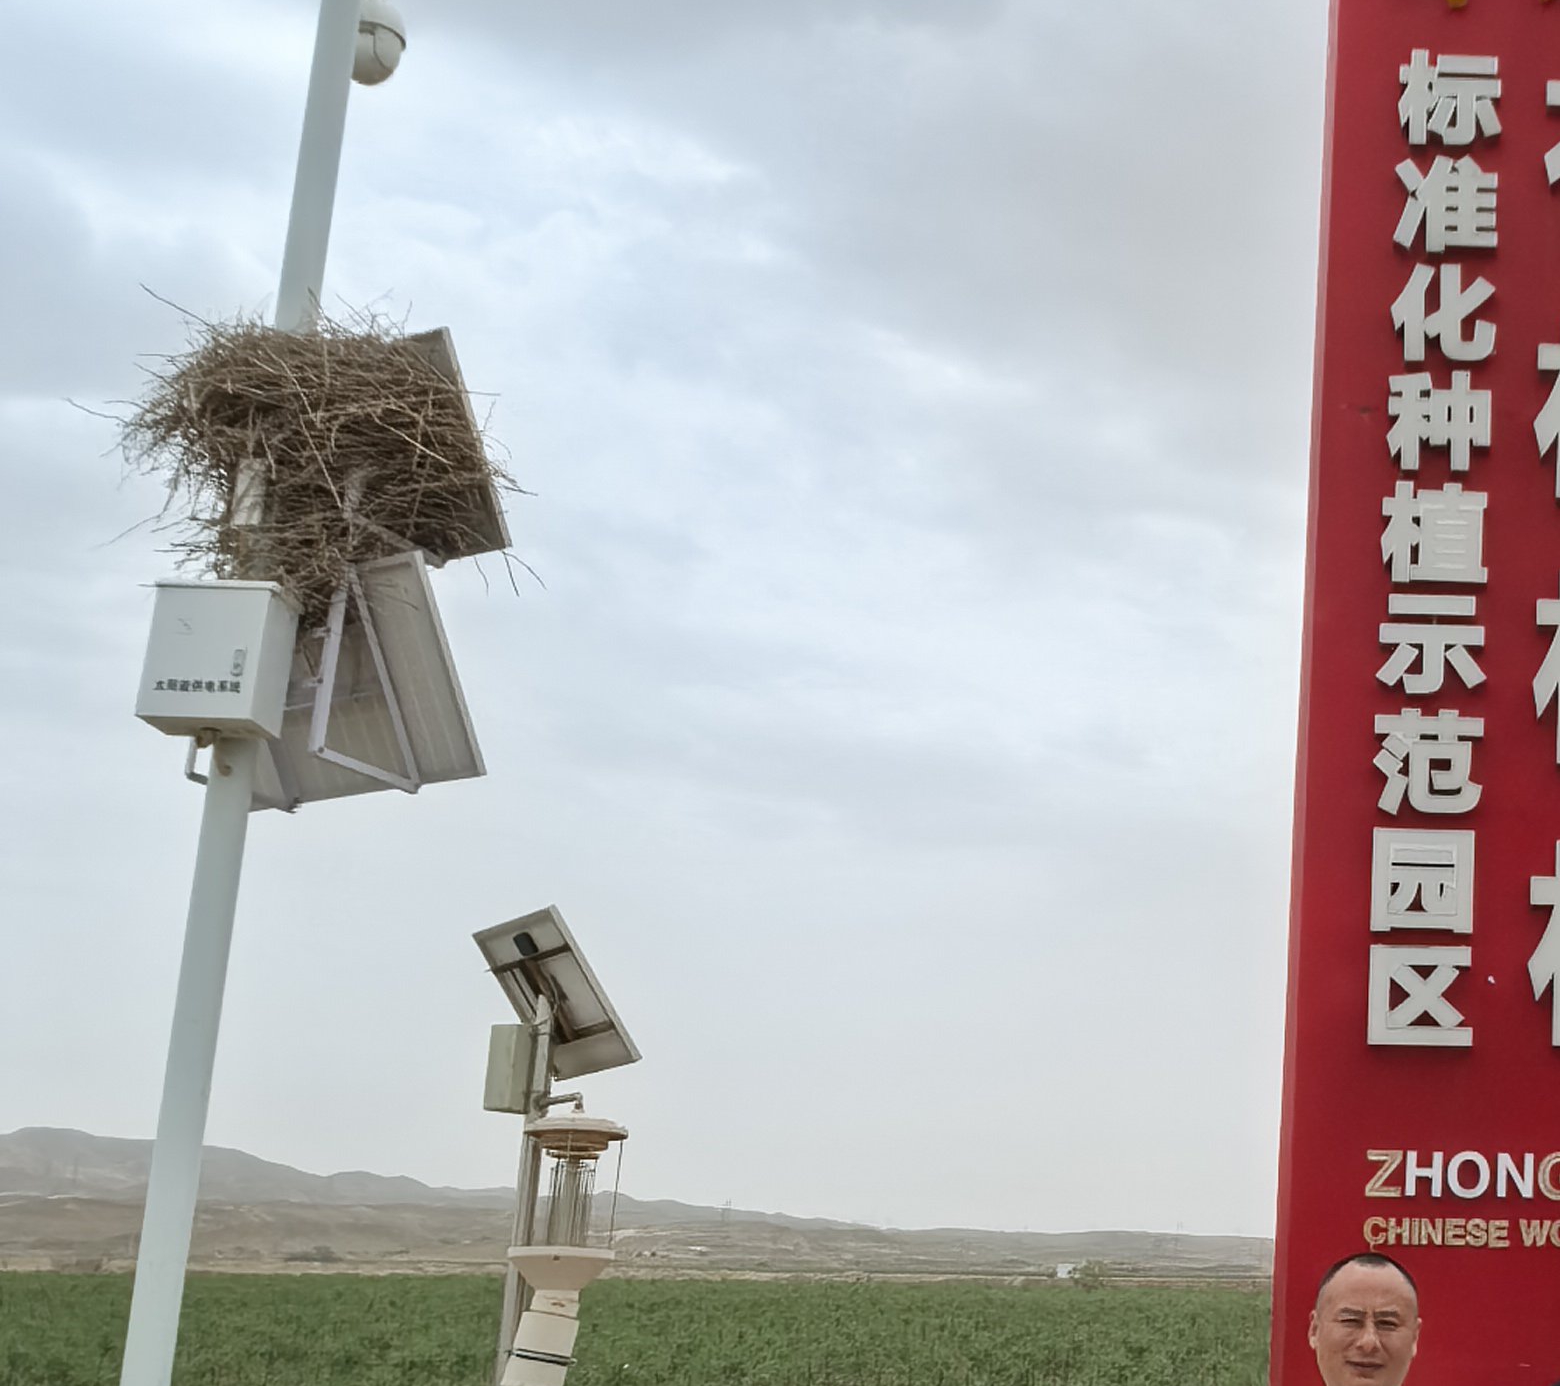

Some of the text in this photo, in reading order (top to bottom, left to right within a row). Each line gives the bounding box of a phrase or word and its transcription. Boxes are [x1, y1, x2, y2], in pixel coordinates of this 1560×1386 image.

[1367, 48, 1502, 1047] 标准化种植示范园区
[1362, 1216, 1511, 1248] CHINESE
